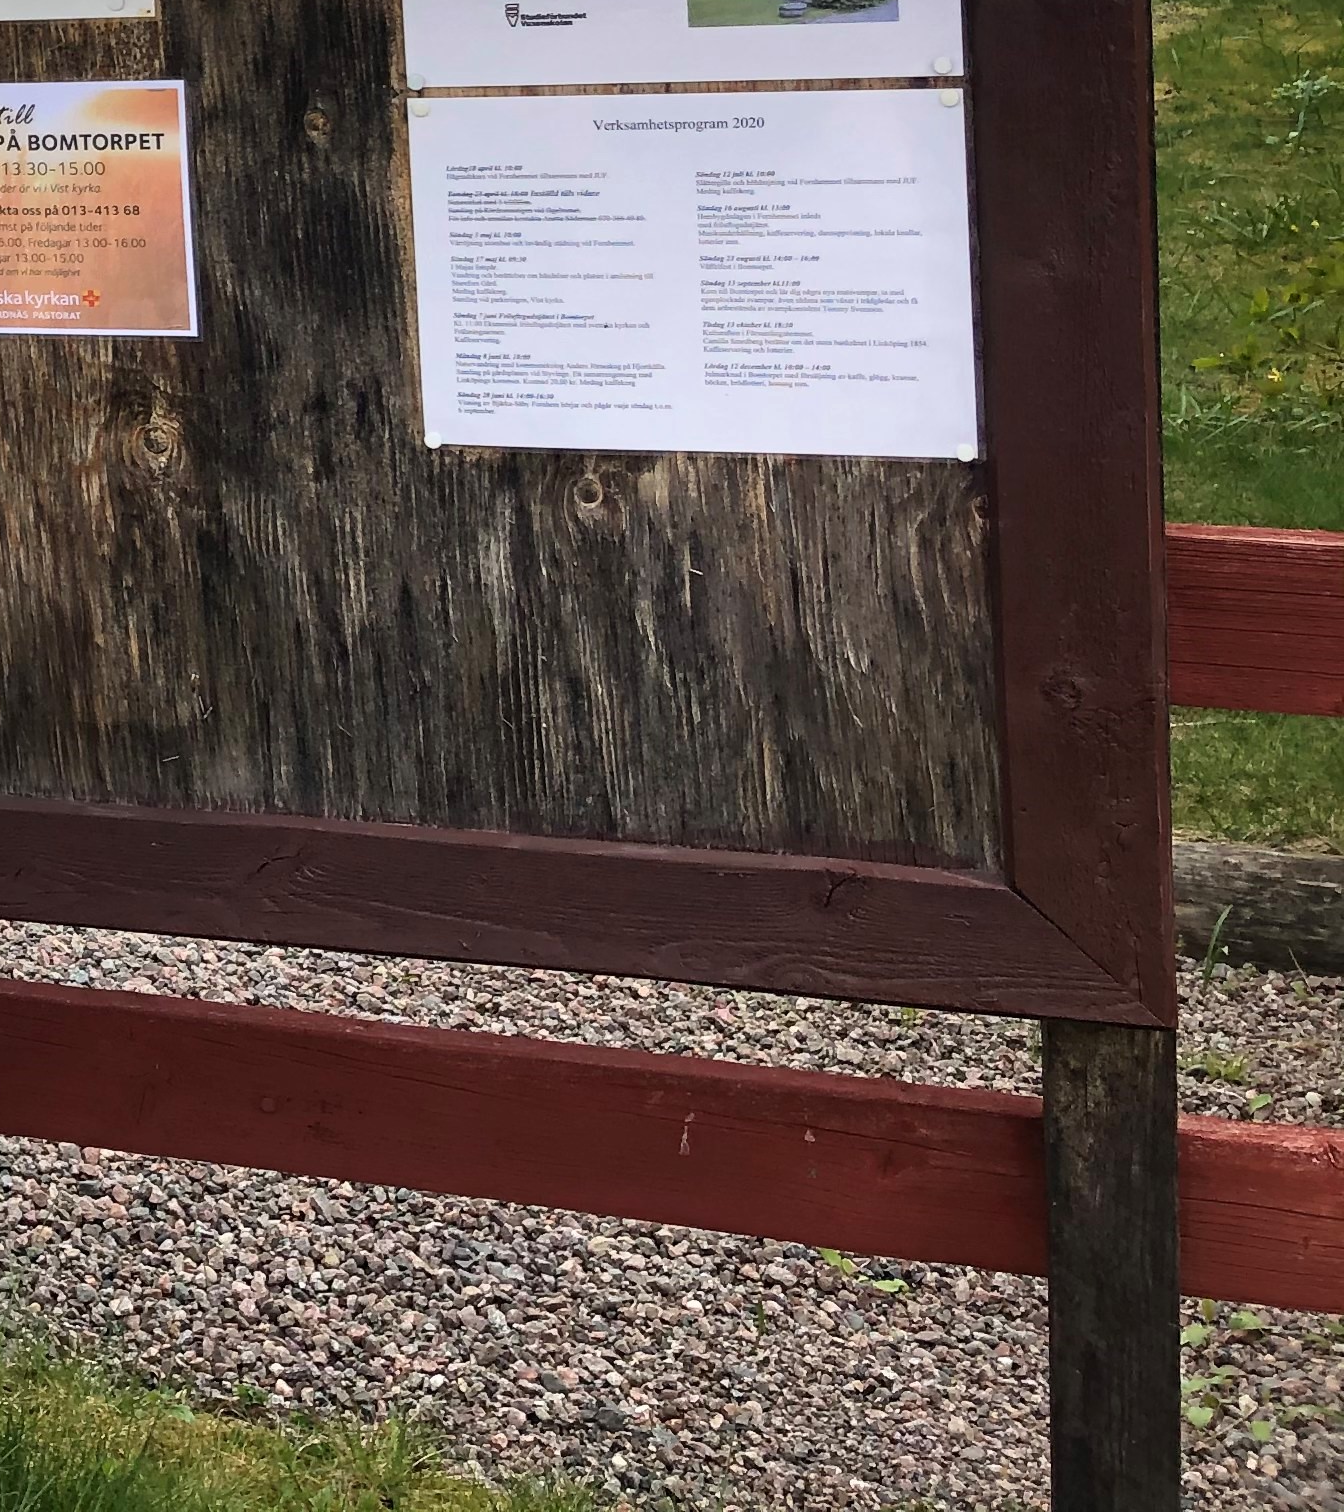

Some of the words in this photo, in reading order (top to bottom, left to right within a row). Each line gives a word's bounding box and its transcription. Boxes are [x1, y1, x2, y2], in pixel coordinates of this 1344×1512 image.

[593, 119, 728, 132] Verksamhetsprogram
[732, 117, 764, 128] 2020
[28, 133, 164, 150] BOMTORPET
[1, 162, 105, 176] 13.30-15.00
[20, 185, 31, 193] är
[50, 184, 69, 193] Vist
[22, 207, 41, 216] oss
[44, 205, 60, 217] på
[62, 206, 119, 216] 013-413
[123, 206, 140, 215] 68
[20, 222, 33, 234] på
[36, 222, 76, 234] följande
[28, 237, 71, 248] Fredagar
[74, 238, 145, 248] 13.00-16.00
[15, 253, 84, 263] 13.00-15.00
[25, 290, 79, 309] kyrkan
[33, 311, 80, 319] PASTORAT
